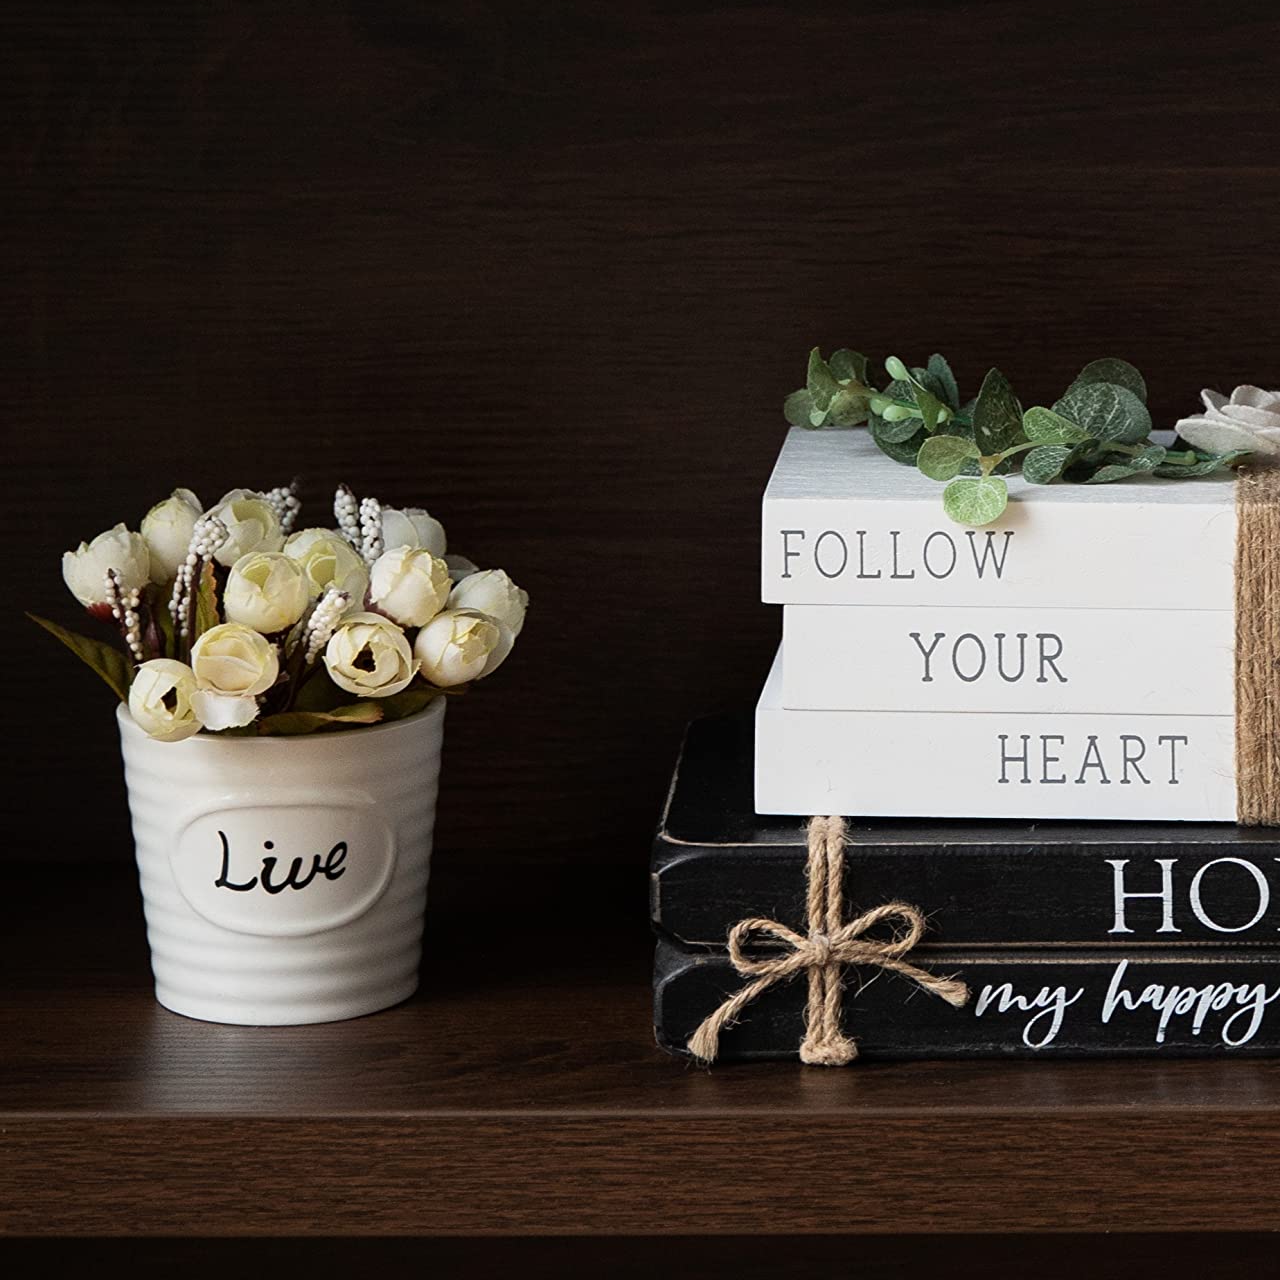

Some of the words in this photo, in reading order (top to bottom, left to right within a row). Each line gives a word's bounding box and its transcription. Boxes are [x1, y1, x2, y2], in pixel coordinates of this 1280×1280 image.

[779, 530, 1016, 580] FOLLOW
[909, 633, 1068, 682] YOUR
[998, 735, 1187, 784] HEART
[214, 830, 349, 894] Live
[976, 983, 1084, 1048] my
